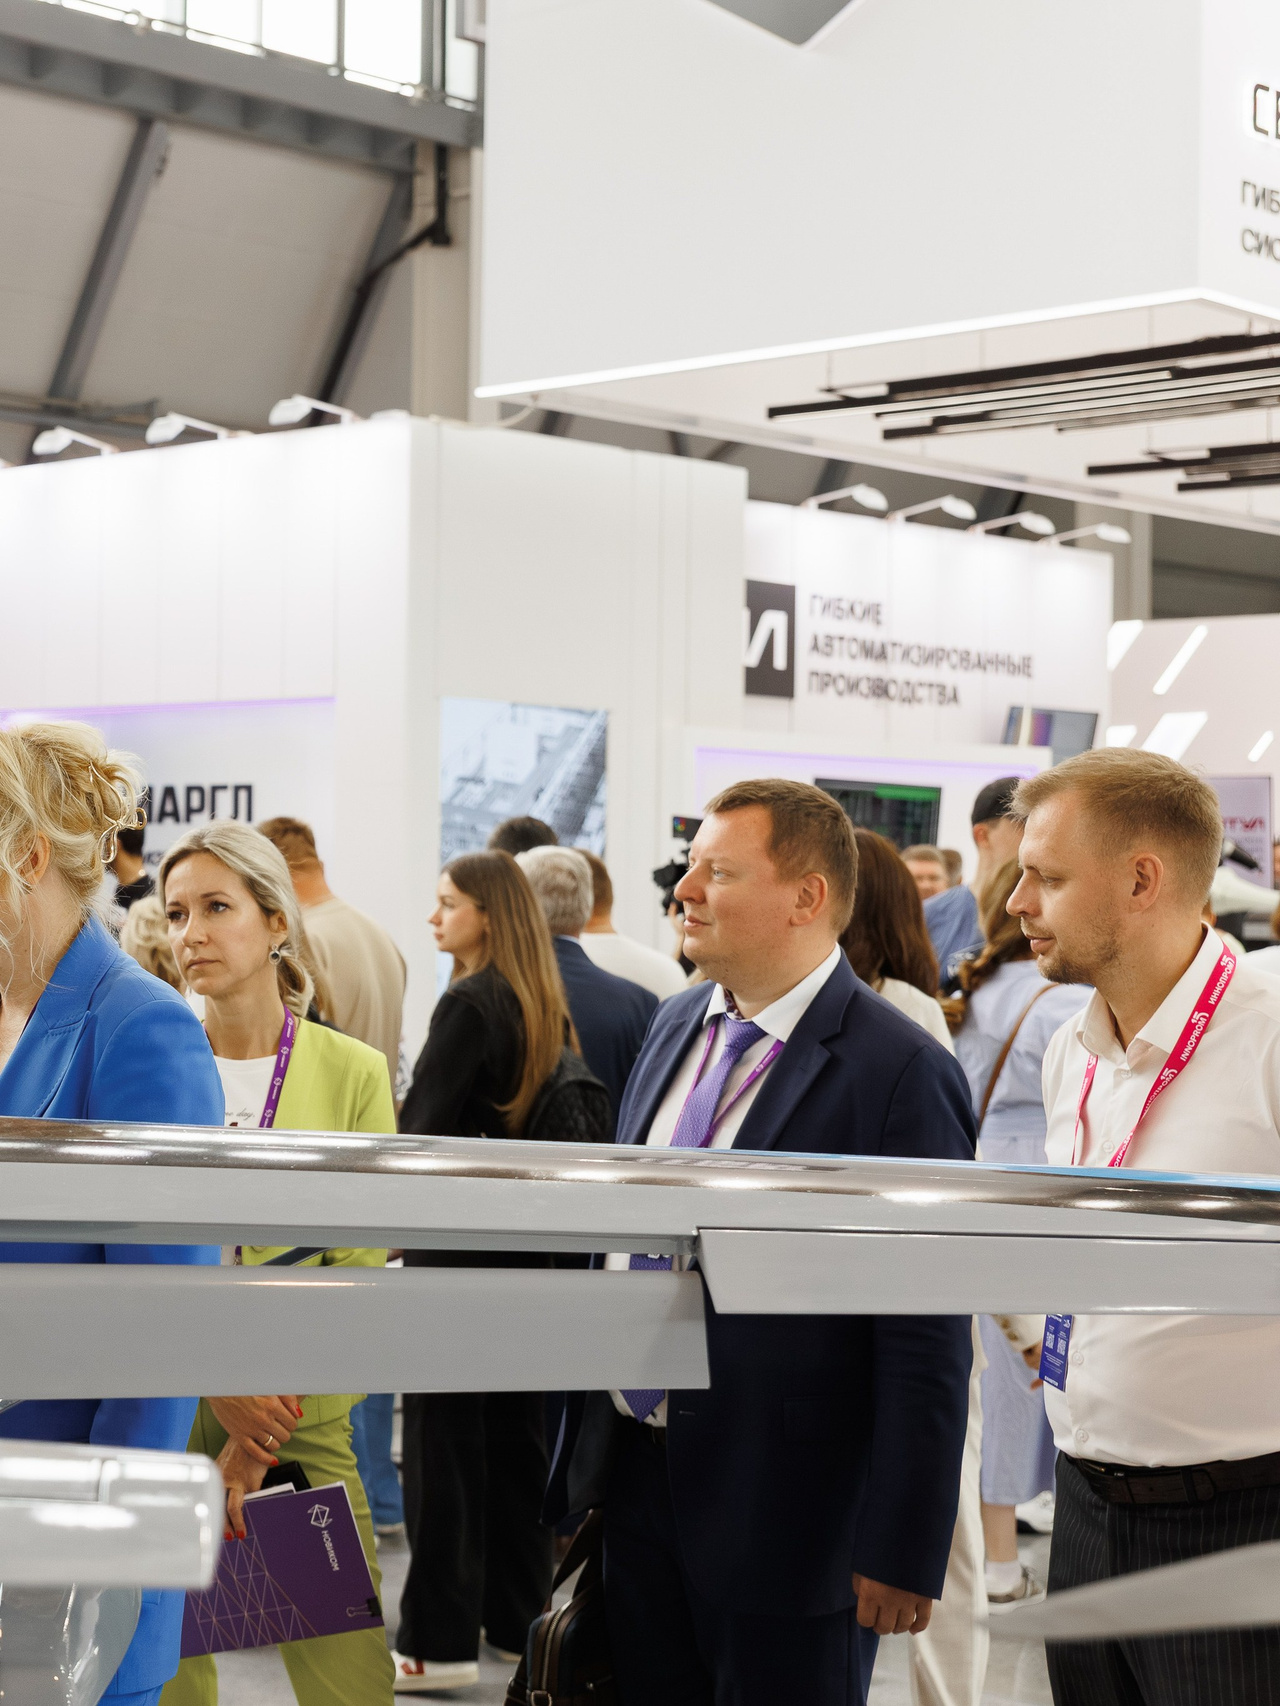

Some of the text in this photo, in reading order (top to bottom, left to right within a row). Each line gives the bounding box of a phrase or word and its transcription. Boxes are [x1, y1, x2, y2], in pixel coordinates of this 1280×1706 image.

[810, 594, 882, 626] ГИБКИЕ
[809, 633, 1033, 679] АВТОМАТИЗИРОВАННЫЕ
[808, 671, 960, 706] ПРОИЗВОДСТВА
[1208, 960, 1234, 1005] ИННОПРОМ
[1180, 1016, 1207, 1062] INNOPROM
